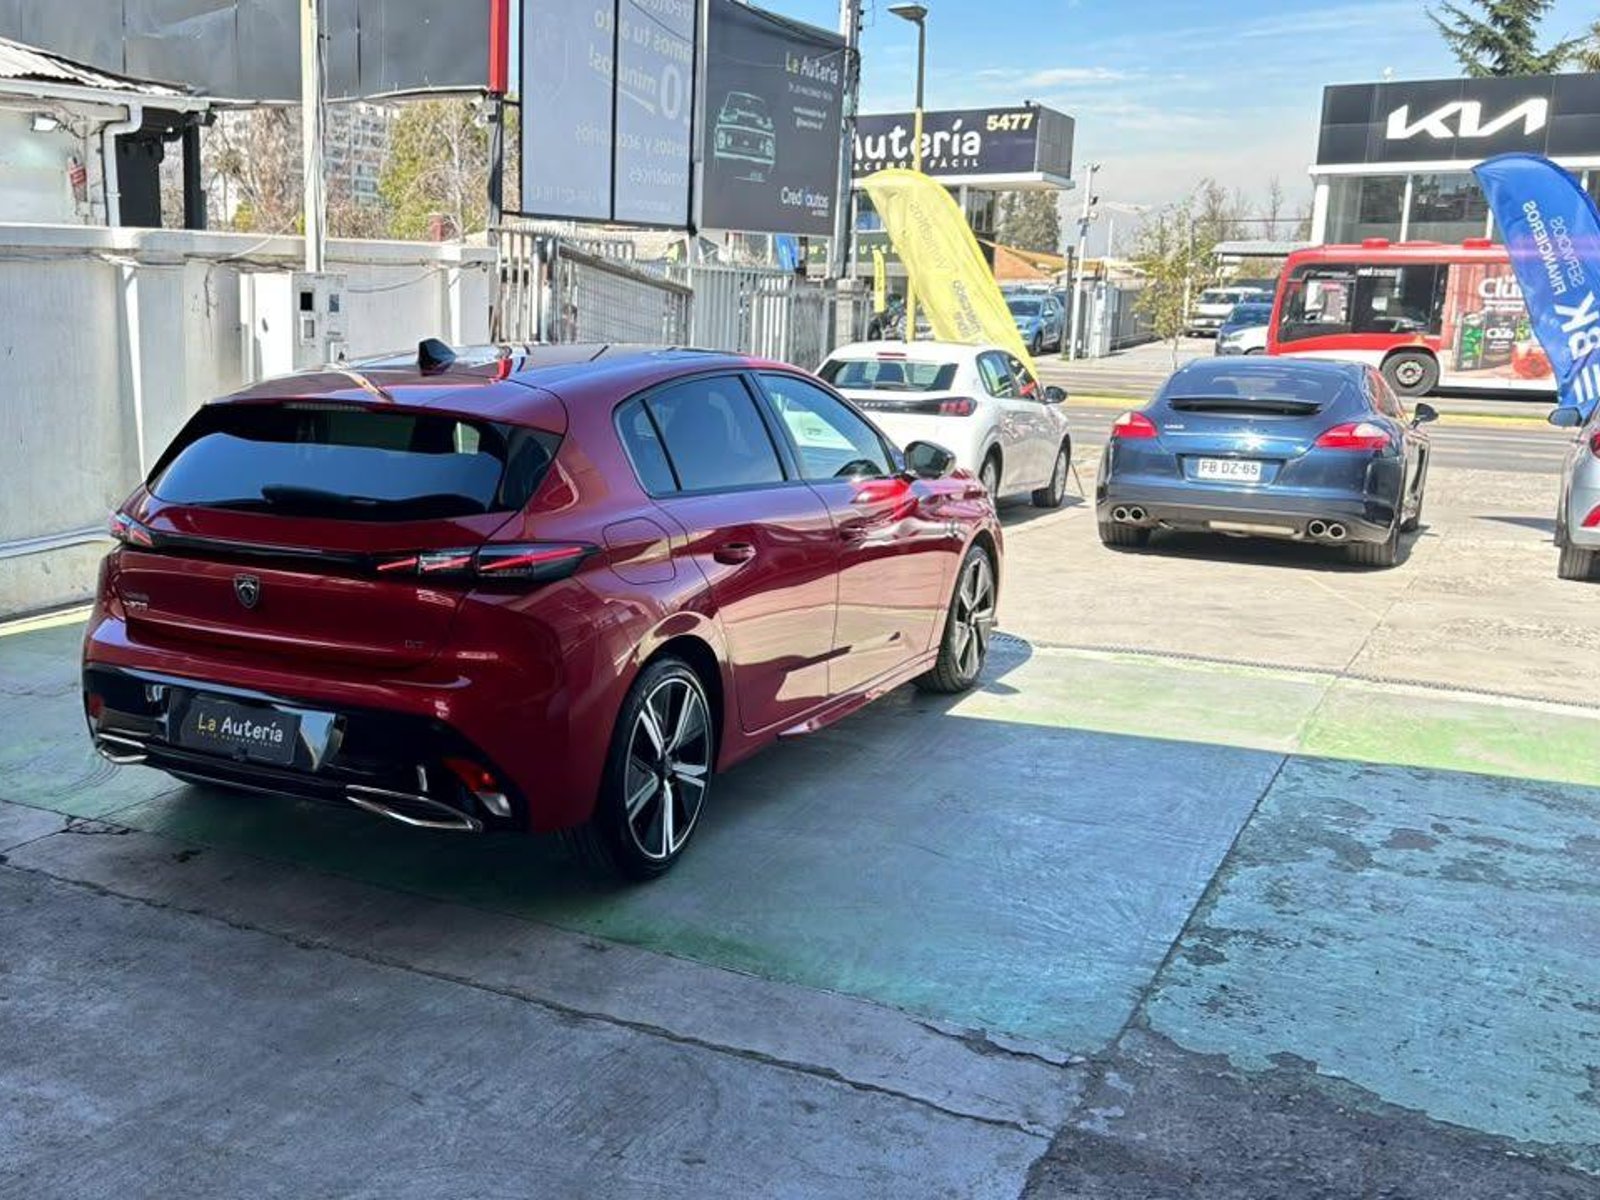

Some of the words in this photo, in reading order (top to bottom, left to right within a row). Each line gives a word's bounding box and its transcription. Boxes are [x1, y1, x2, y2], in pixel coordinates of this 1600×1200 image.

[985, 112, 1034, 132] 5477
[1386, 97, 1548, 139] KIA
[198, 712, 217, 732] La
[221, 716, 284, 743] Autería
